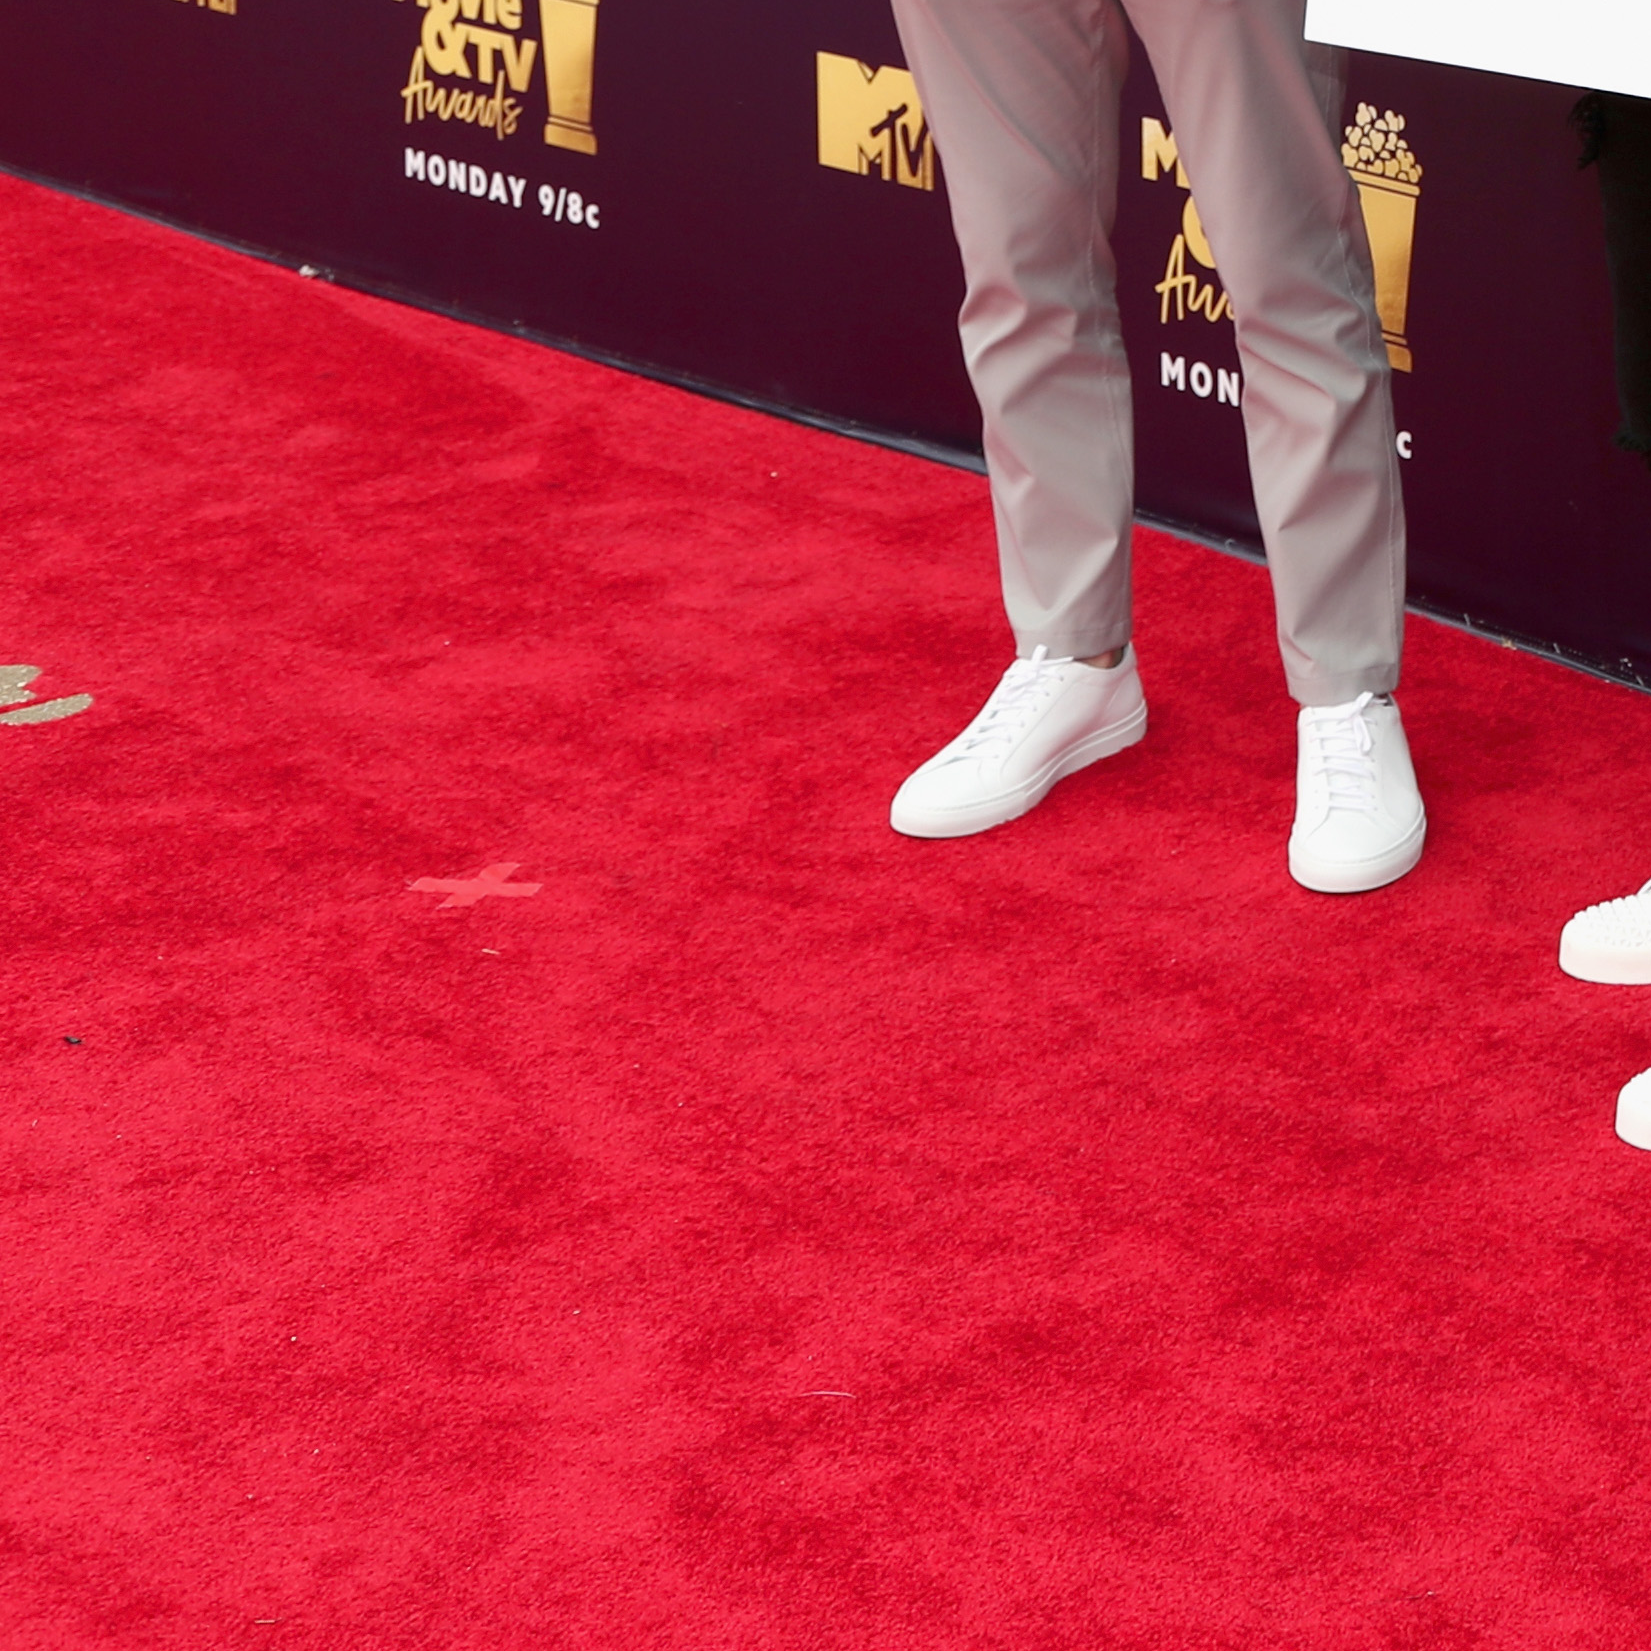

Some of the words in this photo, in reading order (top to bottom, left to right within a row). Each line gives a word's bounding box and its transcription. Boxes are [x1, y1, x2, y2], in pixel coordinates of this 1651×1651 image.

[401, 45, 523, 141] Awards
[817, 50, 934, 191] MTV
[404, 147, 527, 209] MONDAY
[537, 183, 600, 230] 9/8c
[1160, 352, 1240, 408] MON
